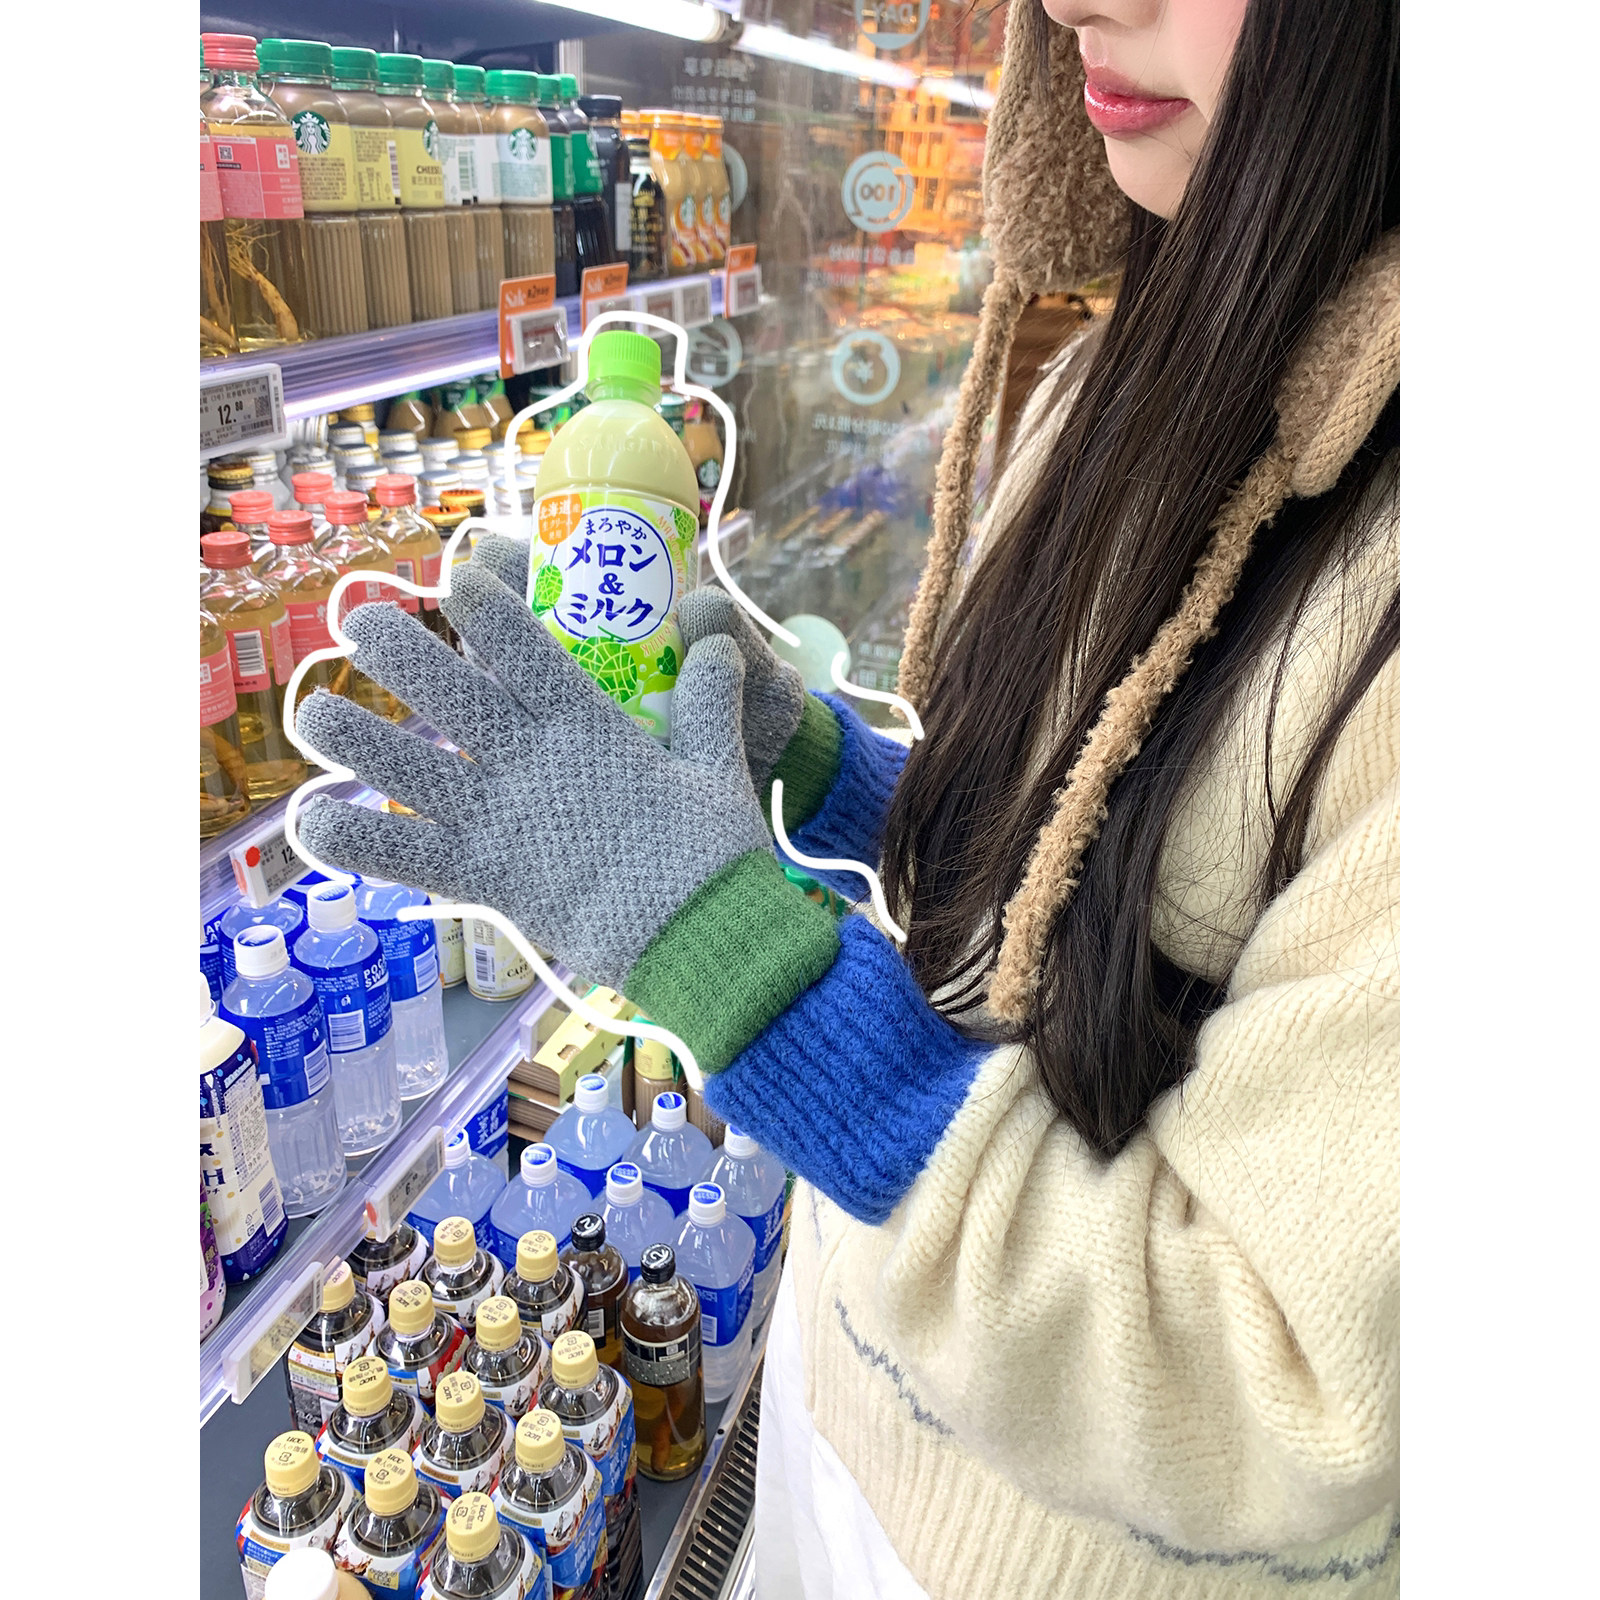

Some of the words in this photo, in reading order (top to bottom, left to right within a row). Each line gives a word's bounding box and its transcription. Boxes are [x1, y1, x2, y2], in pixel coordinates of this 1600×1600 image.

[585, 517, 647, 540] まろやか
[565, 537, 658, 572] メロン
[598, 572, 625, 596] &
[567, 593, 654, 628] ミルク
[203, 1167, 226, 1187] H
[567, 1350, 584, 1360] UCC
[359, 1375, 376, 1386] UCC
[443, 1386, 452, 1400] UCC
[286, 1436, 304, 1444] UCC
[524, 1431, 541, 1441] UCC
[387, 1453, 404, 1465] UCC
[477, 1504, 487, 1522] UCC
